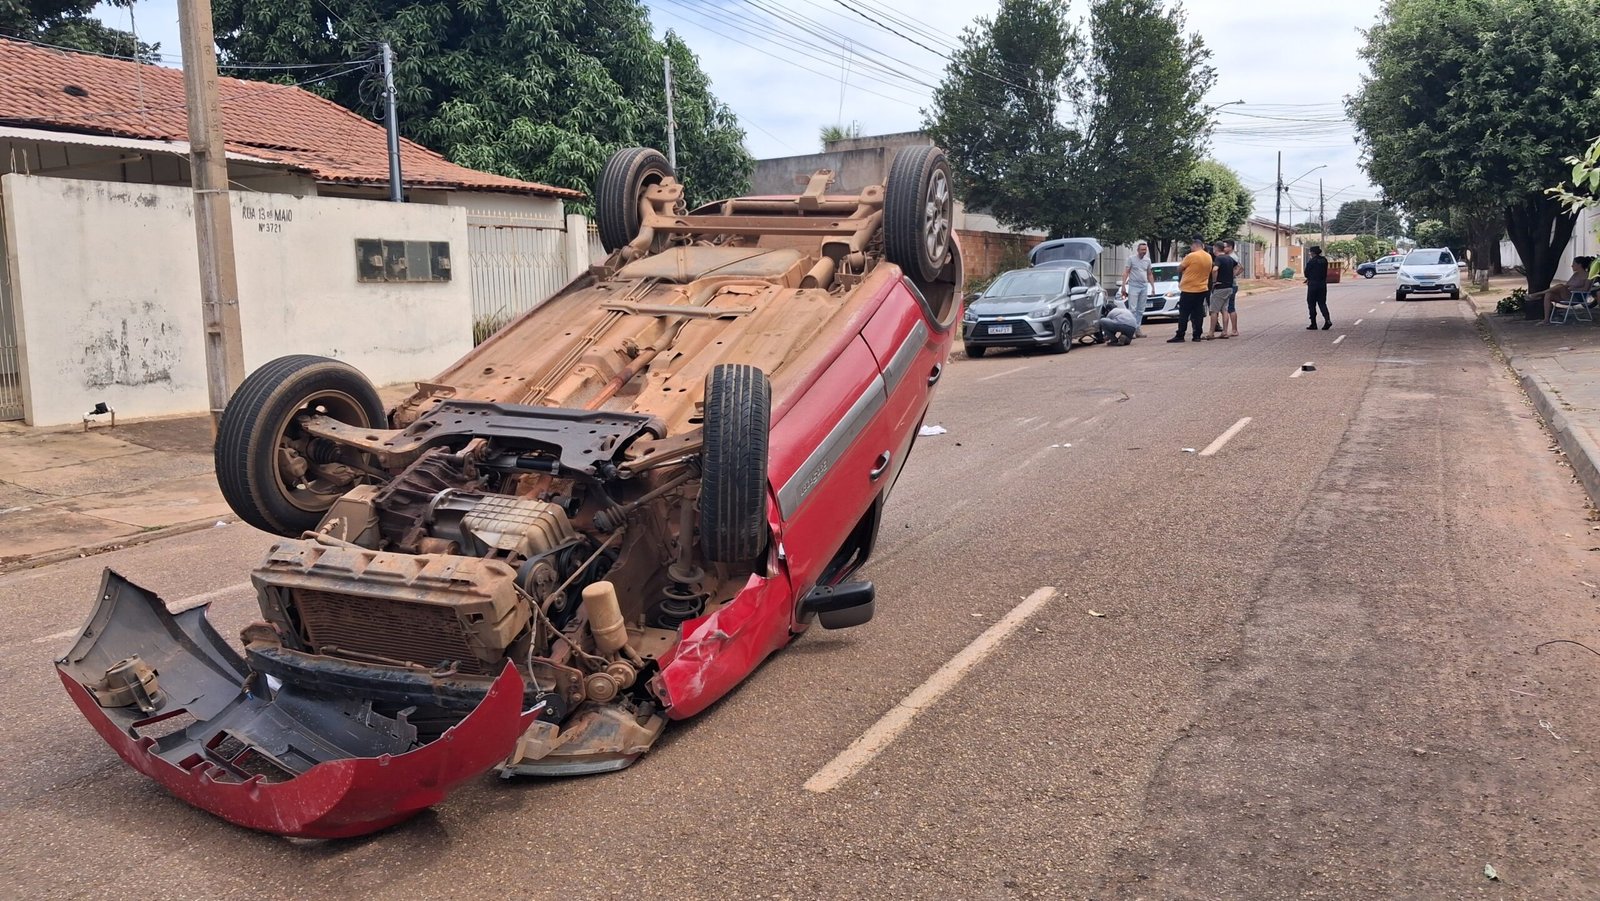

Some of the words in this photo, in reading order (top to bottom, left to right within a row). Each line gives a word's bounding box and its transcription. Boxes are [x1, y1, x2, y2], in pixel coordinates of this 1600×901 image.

[242, 206, 255, 220] RUA
[258, 207, 266, 220] 13
[274, 209, 293, 222] MAIO
[266, 223, 281, 233] 3721
